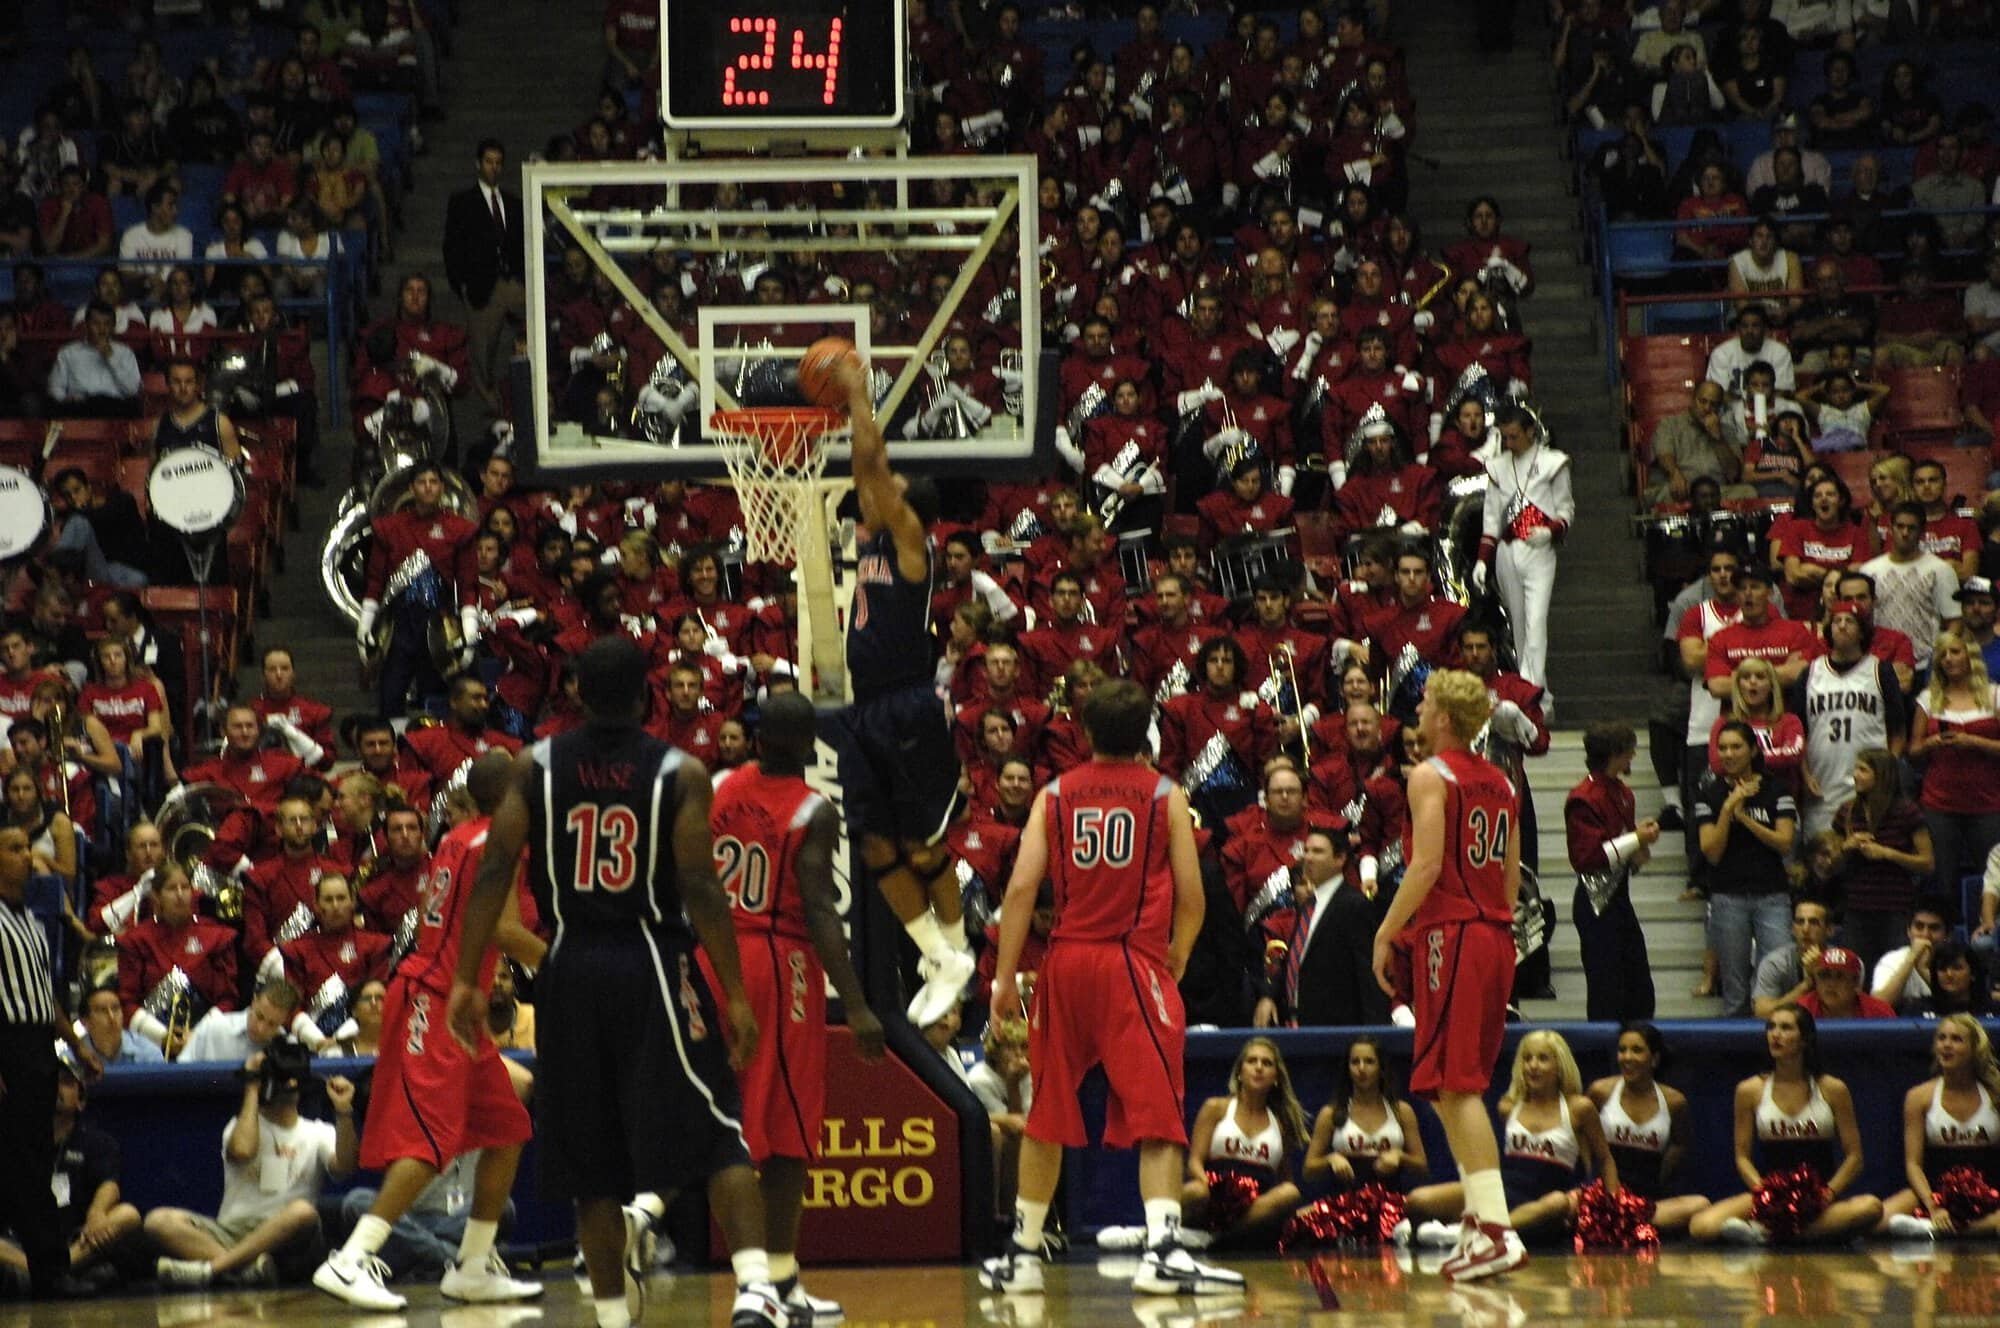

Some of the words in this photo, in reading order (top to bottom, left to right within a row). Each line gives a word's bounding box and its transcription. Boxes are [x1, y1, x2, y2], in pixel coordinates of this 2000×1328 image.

[722, 16, 843, 107] 24
[174, 461, 214, 478] YAMAHA
[1809, 687, 1877, 717] ARIZONA
[1829, 717, 1851, 743] 31
[566, 802, 639, 893] 13
[1072, 807, 1136, 870] 50
[1467, 805, 1510, 870] 34
[713, 834, 770, 914] 20
[817, 1116, 937, 1158] LLS
[802, 1166, 935, 1209] RGO
